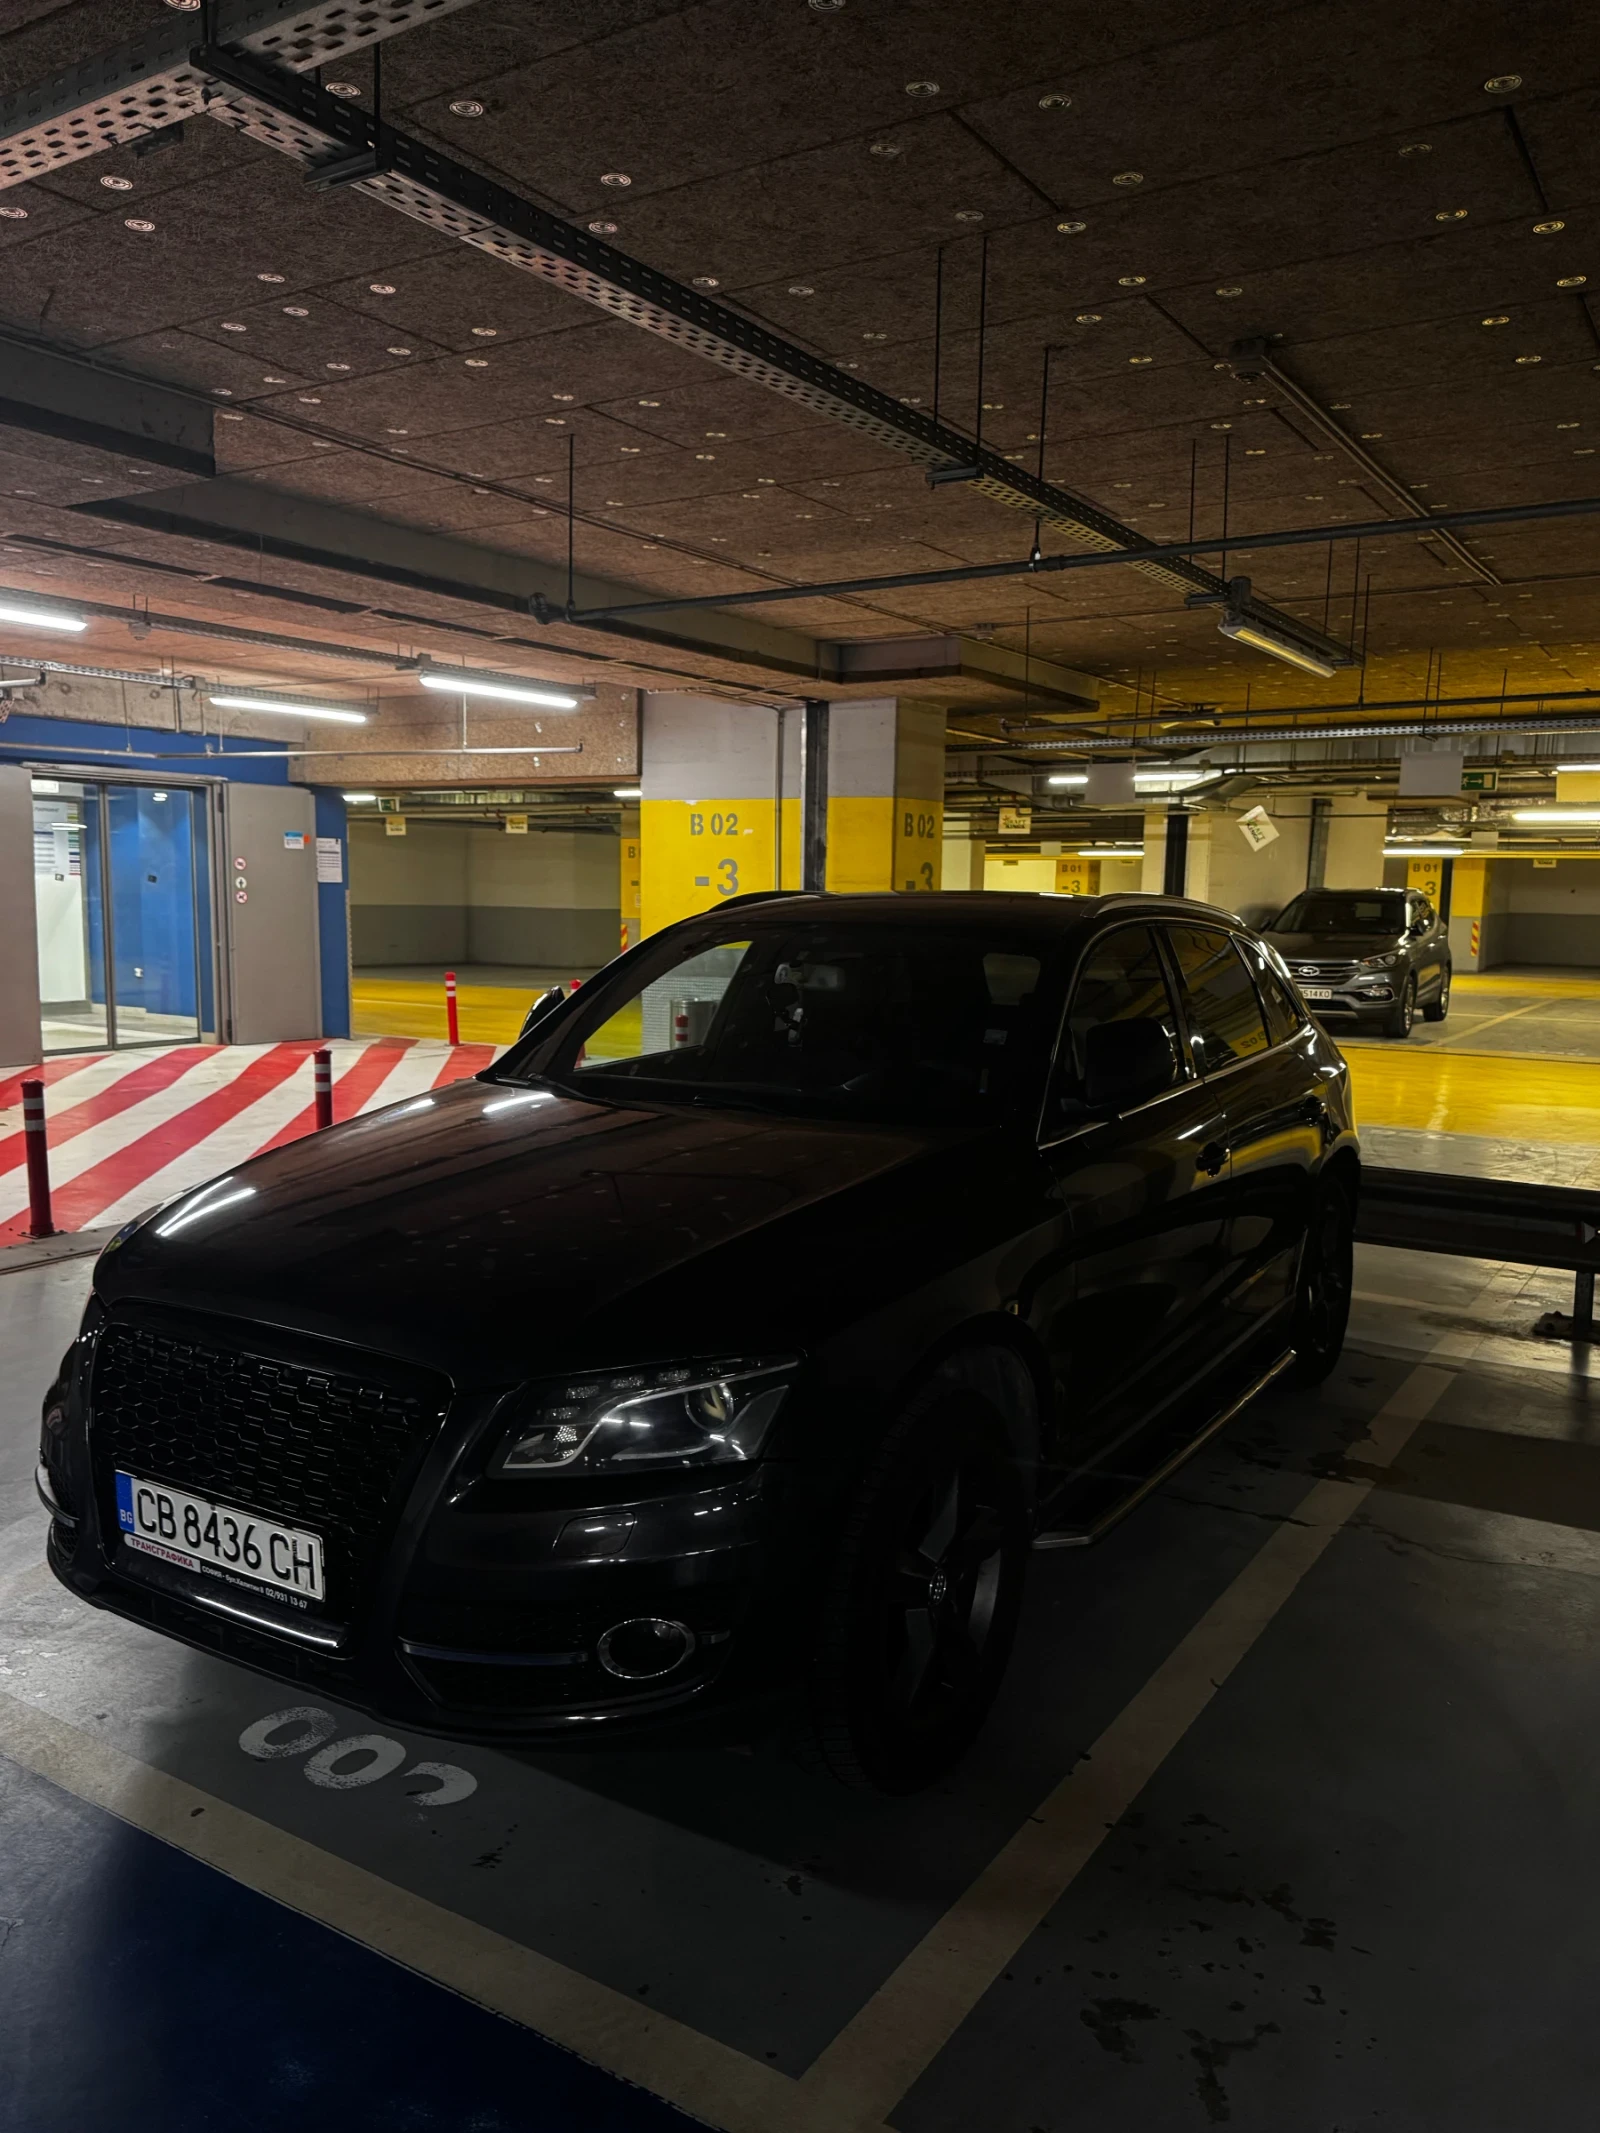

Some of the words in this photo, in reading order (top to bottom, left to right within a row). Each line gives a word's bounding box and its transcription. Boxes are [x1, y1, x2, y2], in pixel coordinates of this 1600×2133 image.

[690, 814, 703, 836] B
[711, 813, 738, 836] 02
[904, 812, 913, 837] B
[917, 814, 935, 839] 02
[1061, 864, 1068, 872] B
[1070, 864, 1082, 873] 01
[1413, 863, 1420, 872] B
[1424, 863, 1438, 873] 01
[119, 1508, 133, 1524] BG
[130, 1536, 194, 1569] ТРАНСГРАФИКА
